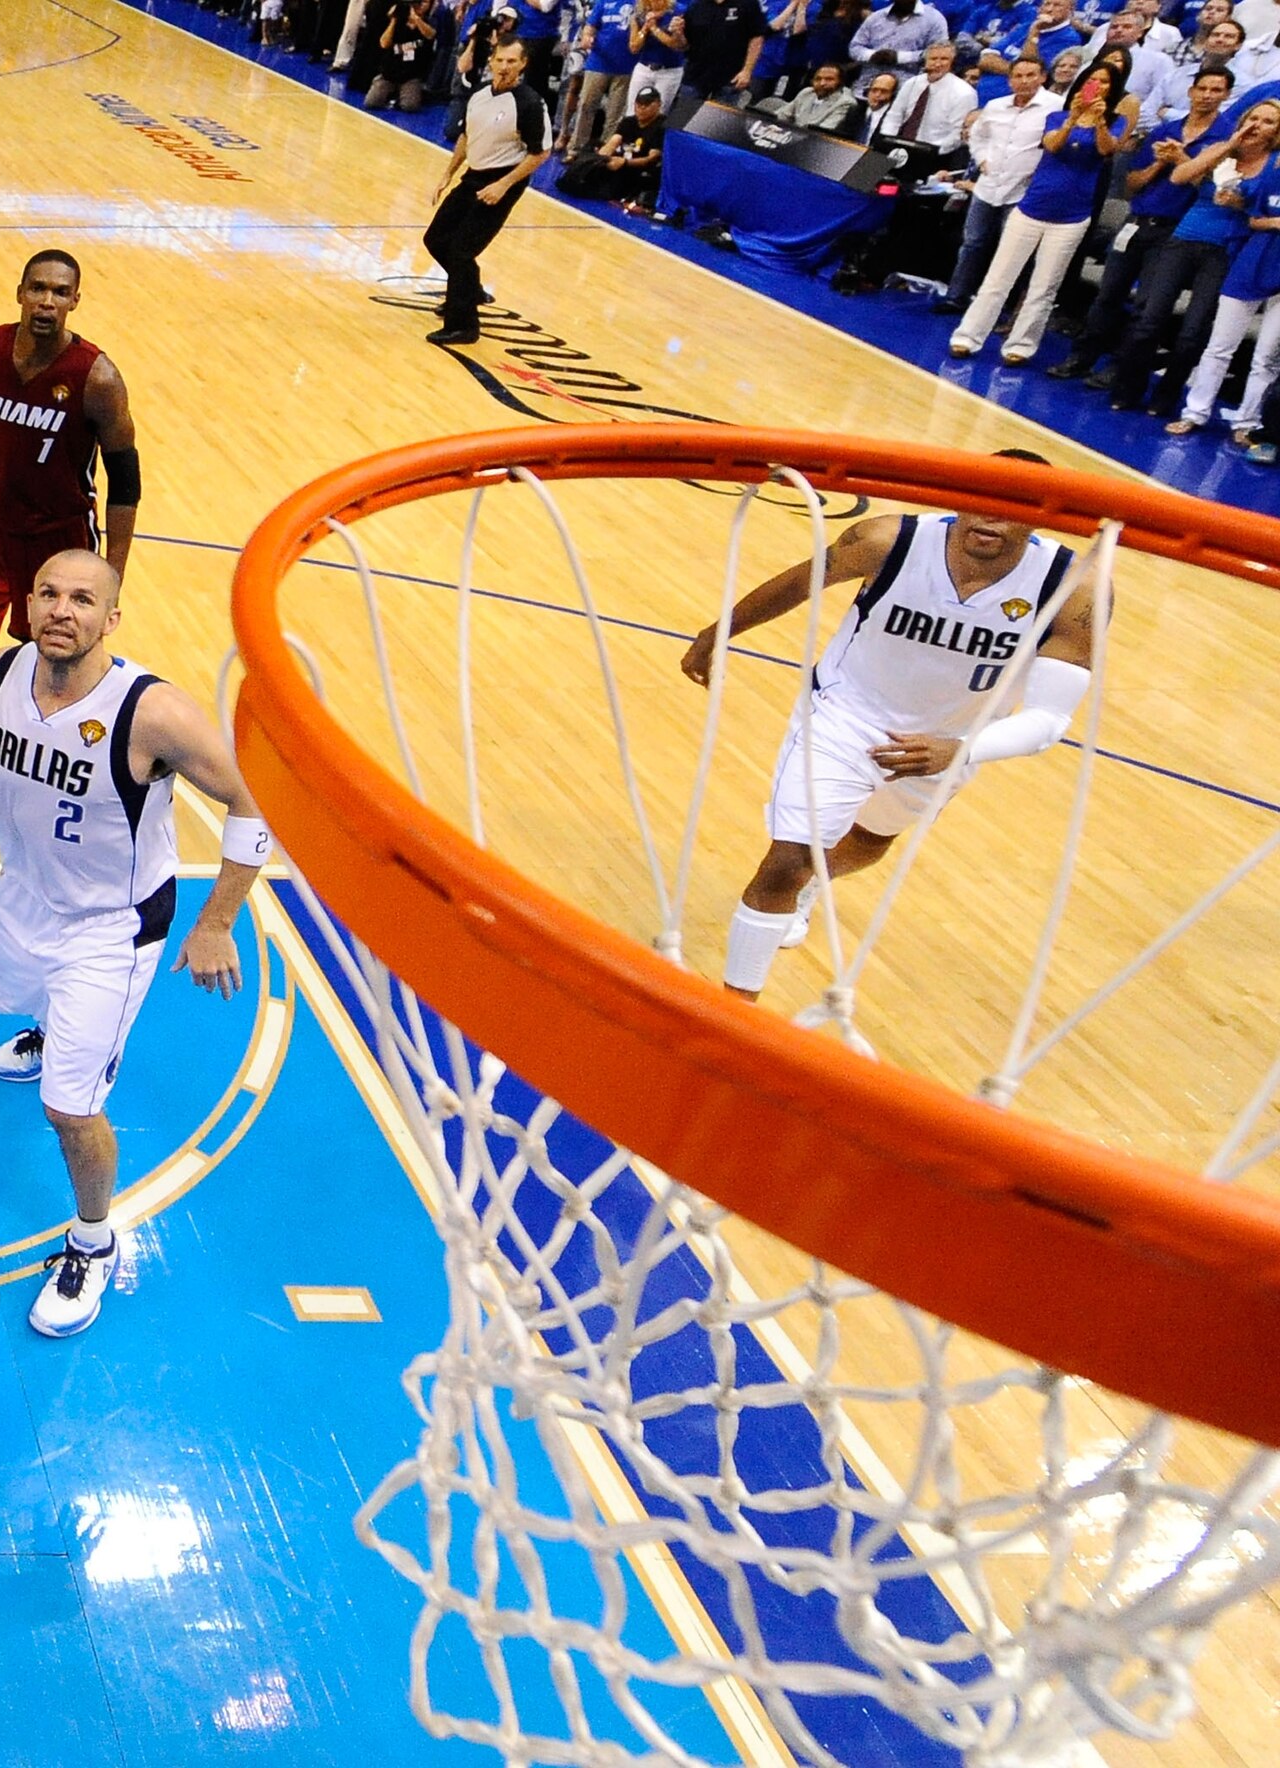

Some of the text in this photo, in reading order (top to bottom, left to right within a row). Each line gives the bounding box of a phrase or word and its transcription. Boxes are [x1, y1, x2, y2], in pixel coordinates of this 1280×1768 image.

[37, 438, 55, 464] 1
[883, 603, 1022, 660] DALLAS
[968, 663, 1006, 692] 0
[53, 799, 85, 844] 2
[255, 831, 268, 854] 2
